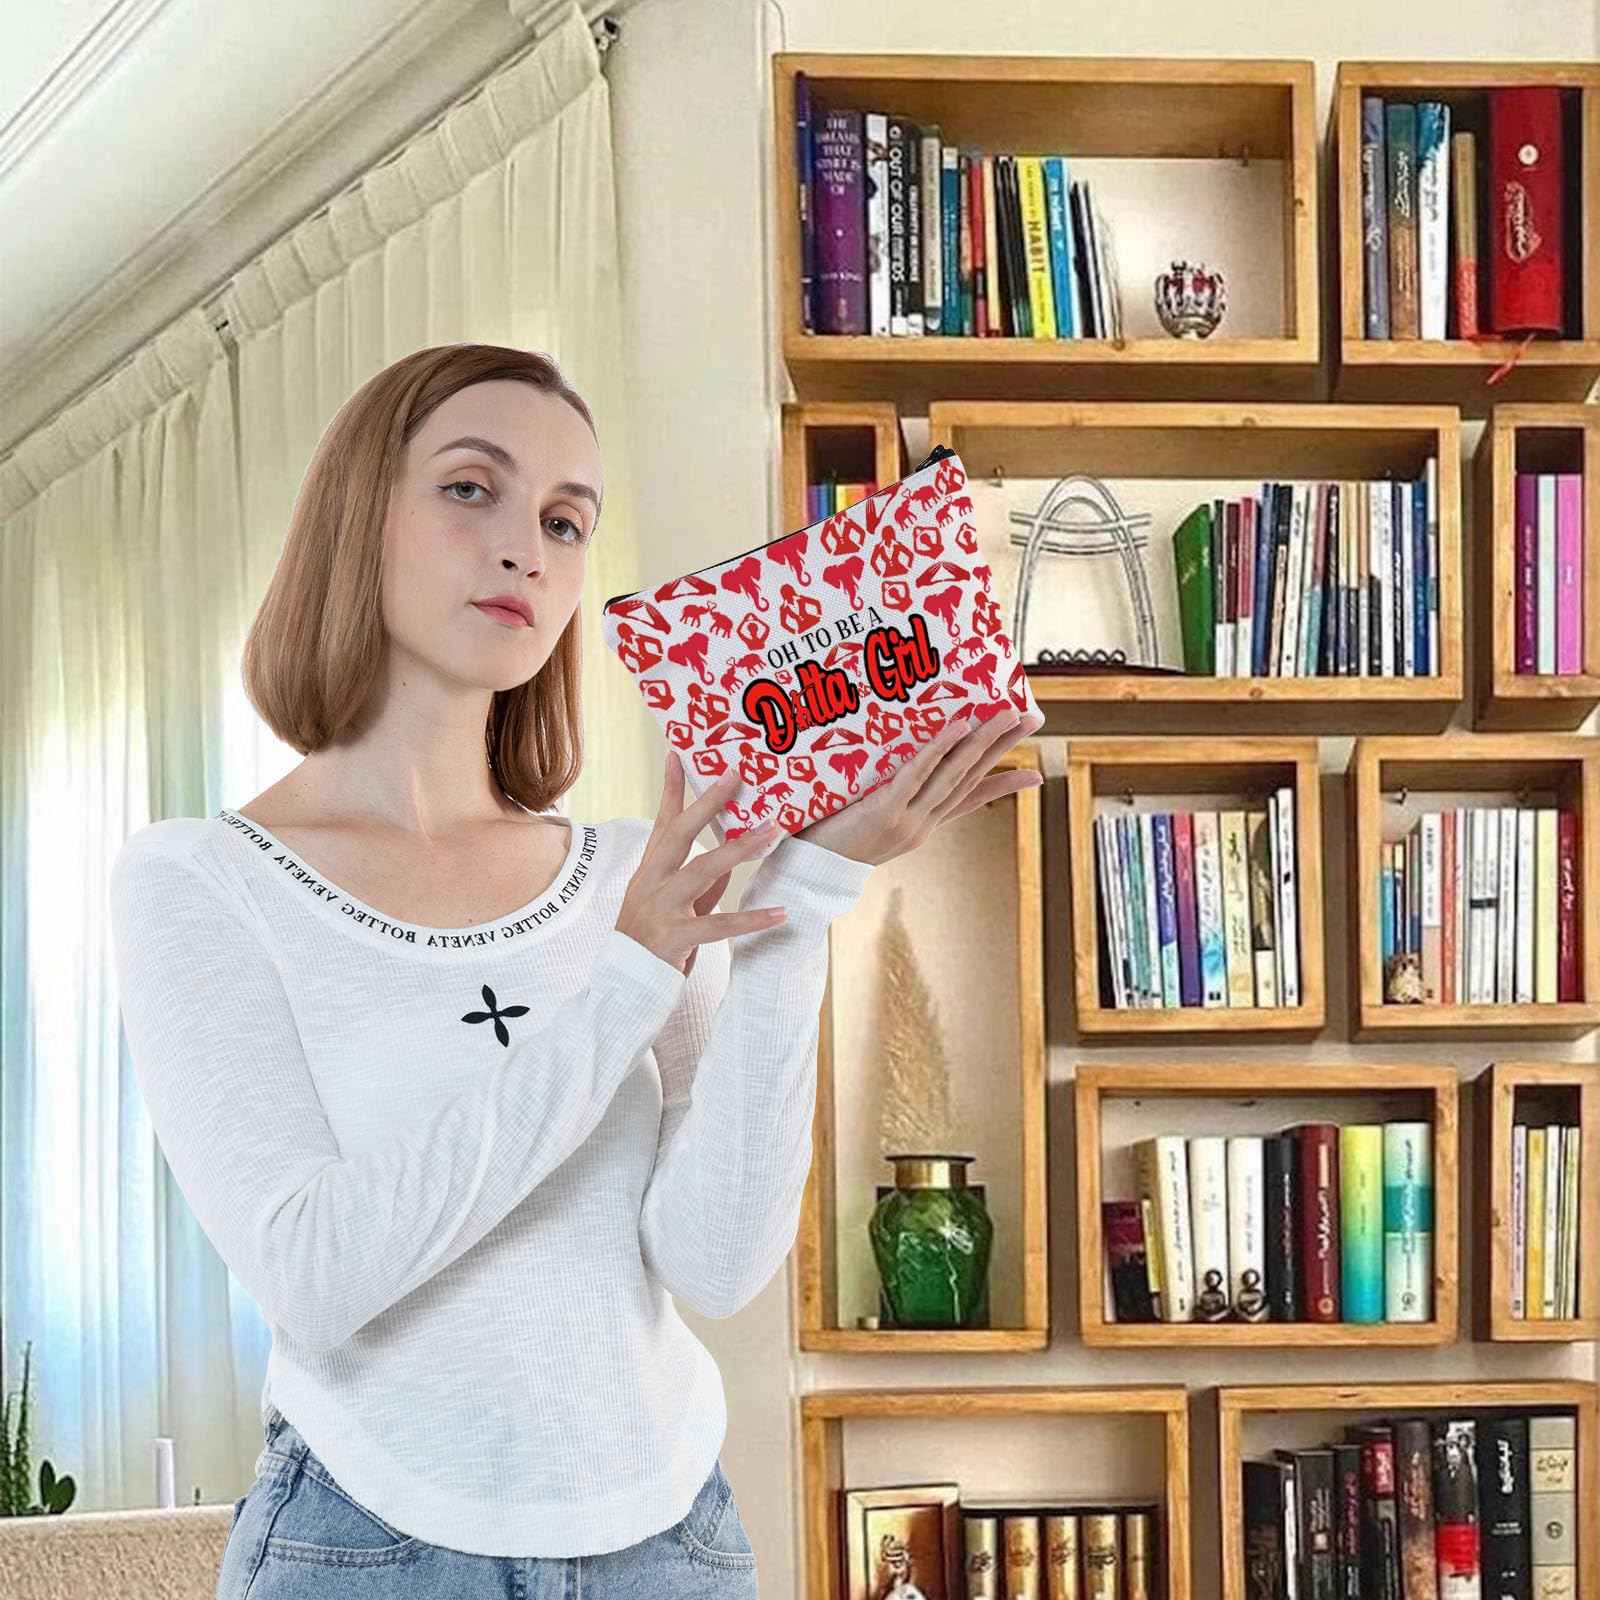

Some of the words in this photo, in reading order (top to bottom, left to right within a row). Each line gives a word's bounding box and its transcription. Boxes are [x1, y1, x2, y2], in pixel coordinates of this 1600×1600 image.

[889, 147, 904, 177] OUT
[890, 179, 905, 201] OF
[891, 203, 906, 234] OUR
[891, 237, 907, 282] MINDS
[1028, 220, 1045, 273] HABIT
[767, 640, 800, 668] OH
[801, 627, 832, 654] TO
[834, 613, 865, 640] BE
[869, 606, 884, 627] A
[742, 659, 860, 755] Dlta
[863, 613, 940, 702] Girl
